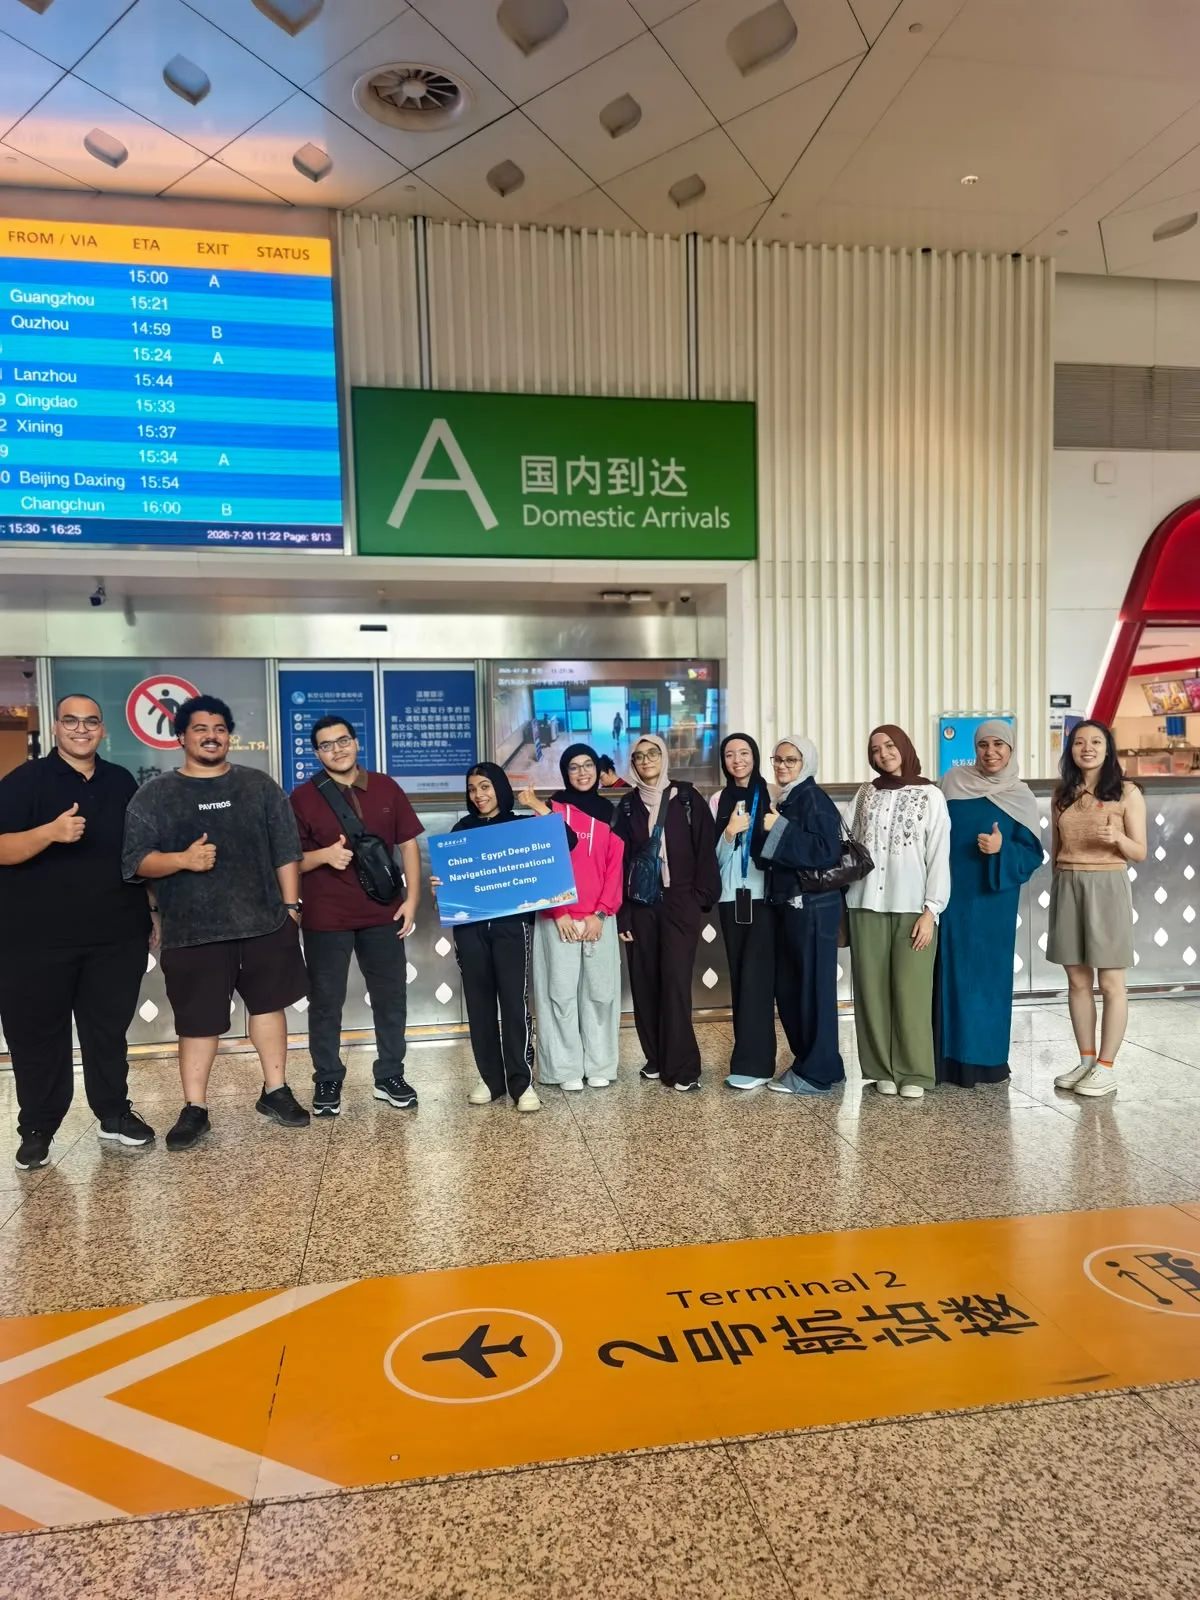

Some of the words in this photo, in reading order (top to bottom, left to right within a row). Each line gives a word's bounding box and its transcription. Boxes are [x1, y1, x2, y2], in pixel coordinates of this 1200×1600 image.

[8, 231, 54, 244] FROM
[70, 234, 97, 247] VIA
[133, 238, 160, 251] ETA
[197, 242, 229, 255] EXIT
[257, 246, 310, 260] STATUS
[129, 269, 168, 284] 15:00
[209, 274, 220, 288] A
[10, 289, 94, 308] Guangzhou
[131, 296, 168, 310] 15:21
[11, 315, 69, 331] Quzhou
[132, 322, 171, 336] 14:59
[211, 325, 223, 339] B
[133, 347, 172, 362] 15:24
[212, 351, 224, 365] A
[14, 367, 77, 383] Lanzhou
[134, 373, 173, 388] 15:44
[16, 393, 78, 411] Qingdao
[136, 399, 175, 413] 15:33
[17, 419, 63, 437] Xining
[137, 424, 176, 438] 15:37
[139, 450, 178, 464] 15:34
[218, 452, 230, 466] A
[20, 470, 70, 488] Beijing
[74, 472, 125, 490] Daxing
[140, 476, 179, 489] 15:54
[386, 418, 499, 531] A
[521, 455, 688, 497] 国内到达
[21, 496, 105, 514] Changchun
[142, 501, 181, 514] 16:00
[221, 503, 232, 516] B
[523, 504, 635, 529] Domestic
[641, 505, 730, 530] Arrivals
[9, 523, 40, 534] 15:30
[51, 524, 82, 535] 16:25
[207, 530, 254, 540] 2026-7-20
[256, 531, 281, 541] 11:22
[283, 532, 309, 543] Page:
[311, 532, 332, 542] 8/13
[198, 800, 231, 811] PAVTROS
[448, 857, 473, 867] China
[481, 850, 507, 861] Egypt
[508, 845, 530, 856] Deep
[531, 842, 551, 851] Blue
[449, 868, 497, 882] Navigation
[499, 856, 555, 873] International
[474, 881, 511, 893] Summer
[512, 876, 537, 887] Camp
[666, 1272, 871, 1309] Terminal
[874, 1270, 907, 1288] 2
